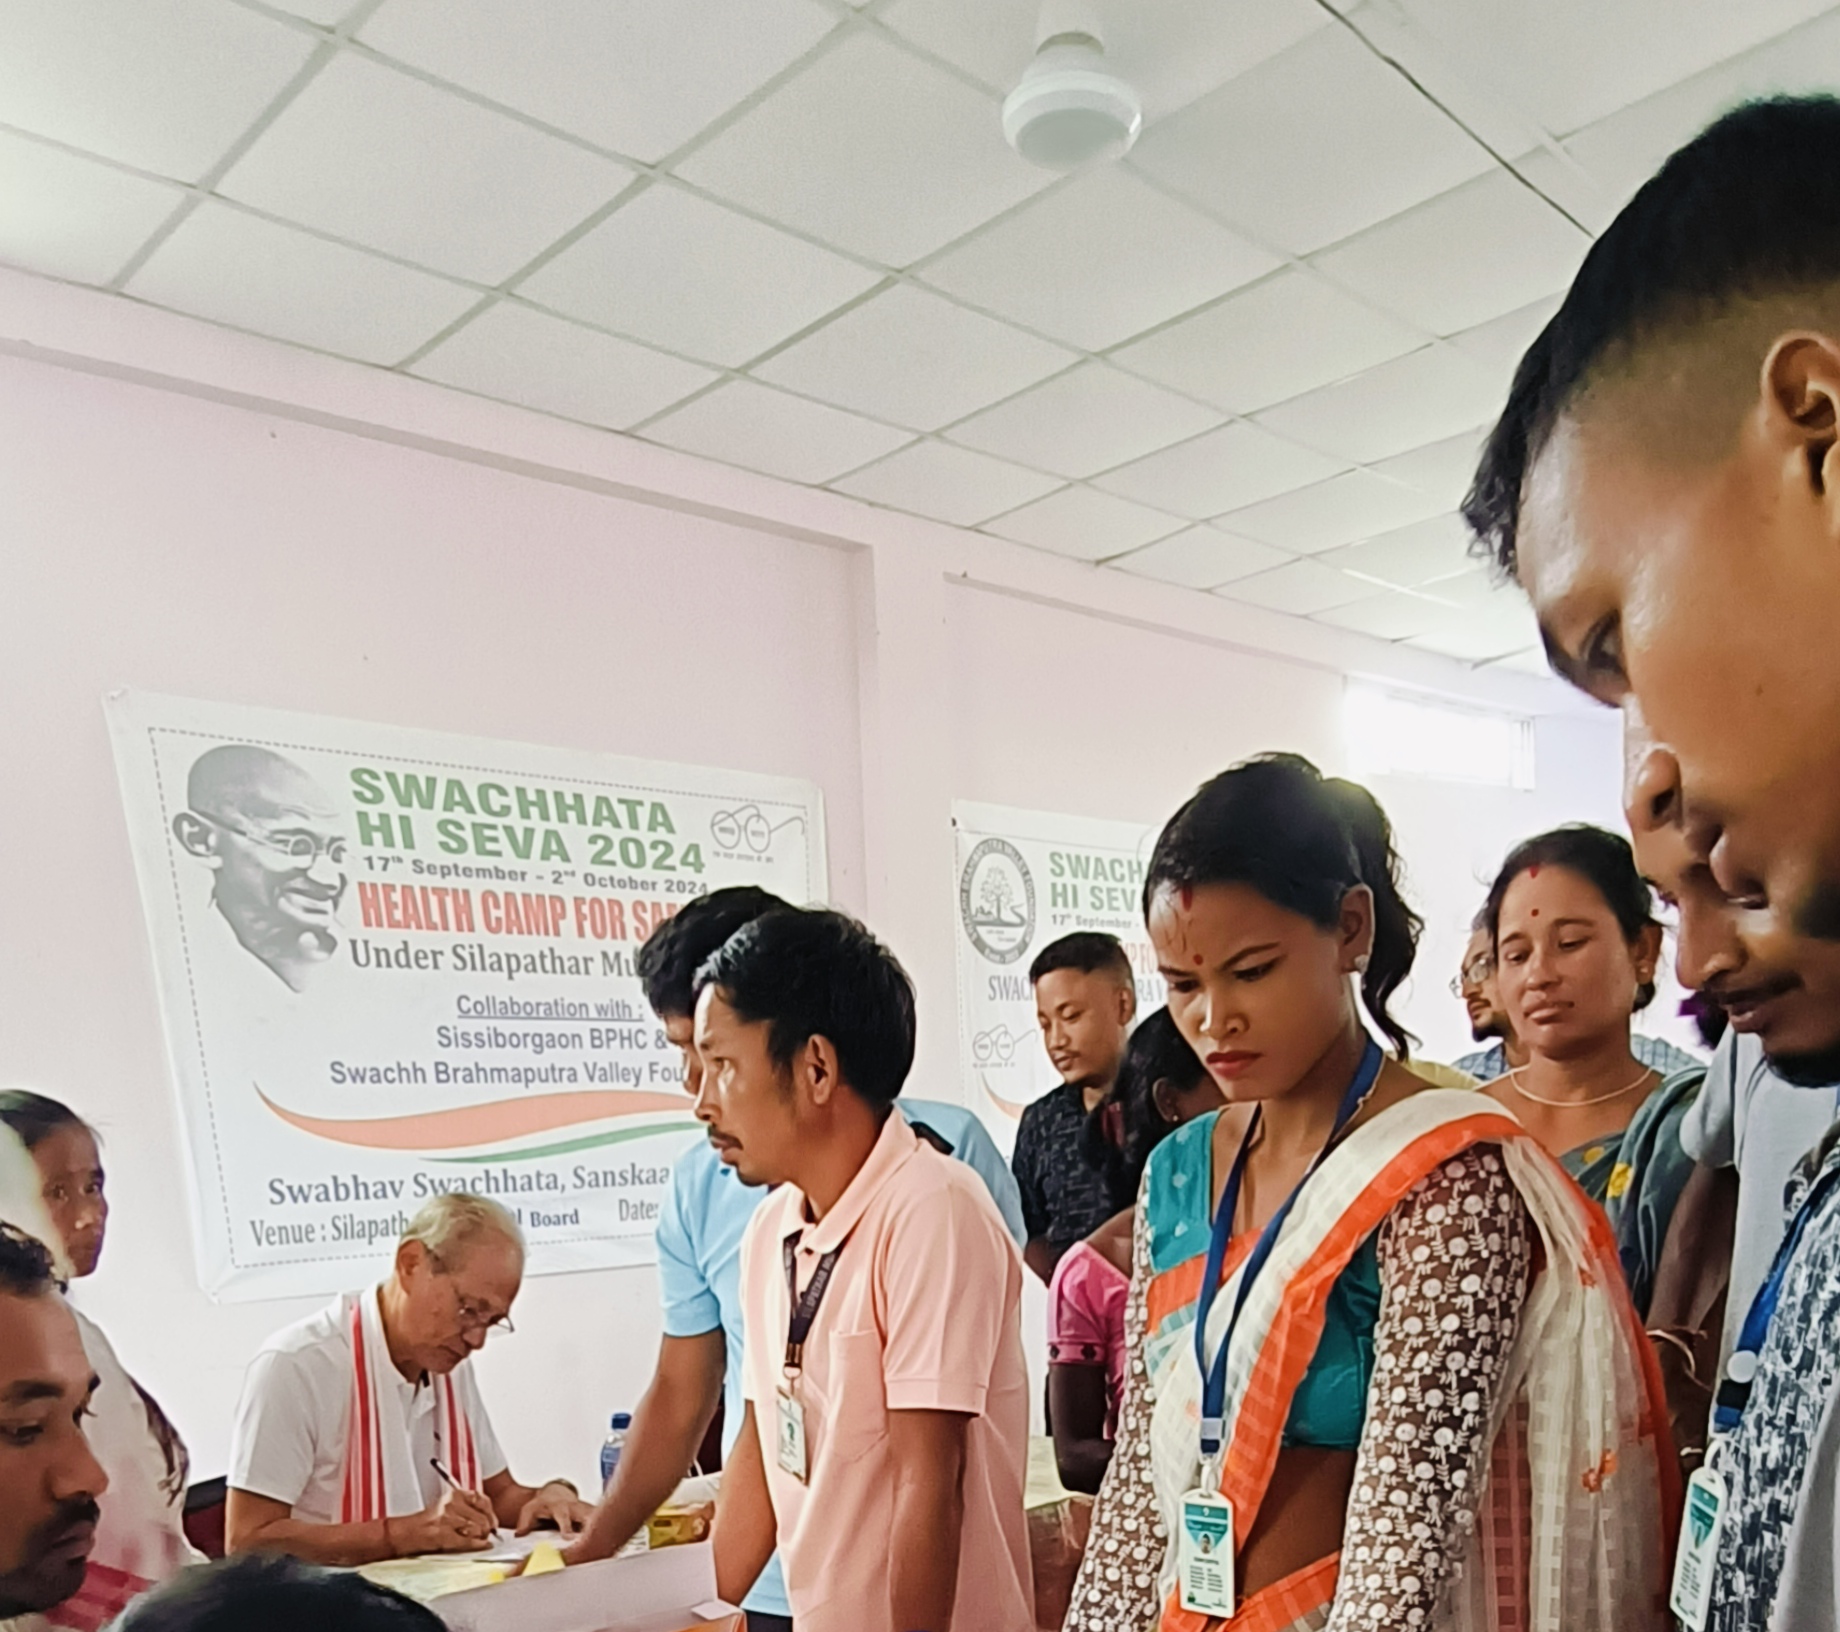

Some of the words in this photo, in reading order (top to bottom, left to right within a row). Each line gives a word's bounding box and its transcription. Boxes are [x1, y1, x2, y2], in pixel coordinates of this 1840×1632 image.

[350, 767, 676, 834] SWACHHATA
[356, 811, 415, 850] HI
[436, 818, 572, 863] SEVA
[588, 834, 706, 874] 2024
[411, 859, 528, 881] September
[583, 872, 658, 892] October
[664, 879, 708, 896] 2024
[1050, 882, 1079, 909] HI
[357, 881, 475, 933] HEALTH
[480, 889, 567, 937] CAMP
[573, 896, 627, 941] FOR
[1075, 914, 1131, 929] September
[348, 938, 444, 970] Under
[452, 942, 594, 981] Silapathar
[456, 995, 589, 1018] Collaboration
[593, 999, 632, 1019] with
[436, 1026, 583, 1054] Sissiborgaon
[589, 1028, 648, 1050] BPHC
[654, 1029, 668, 1050] &
[330, 1061, 427, 1085] Swachh
[434, 1061, 578, 1089] Brahmaputra
[584, 1061, 642, 1088] Valley
[268, 1174, 404, 1206] Swabhav
[413, 1167, 565, 1198] Swachhata,
[249, 1219, 315, 1247] Venue
[530, 1208, 580, 1228] Board
